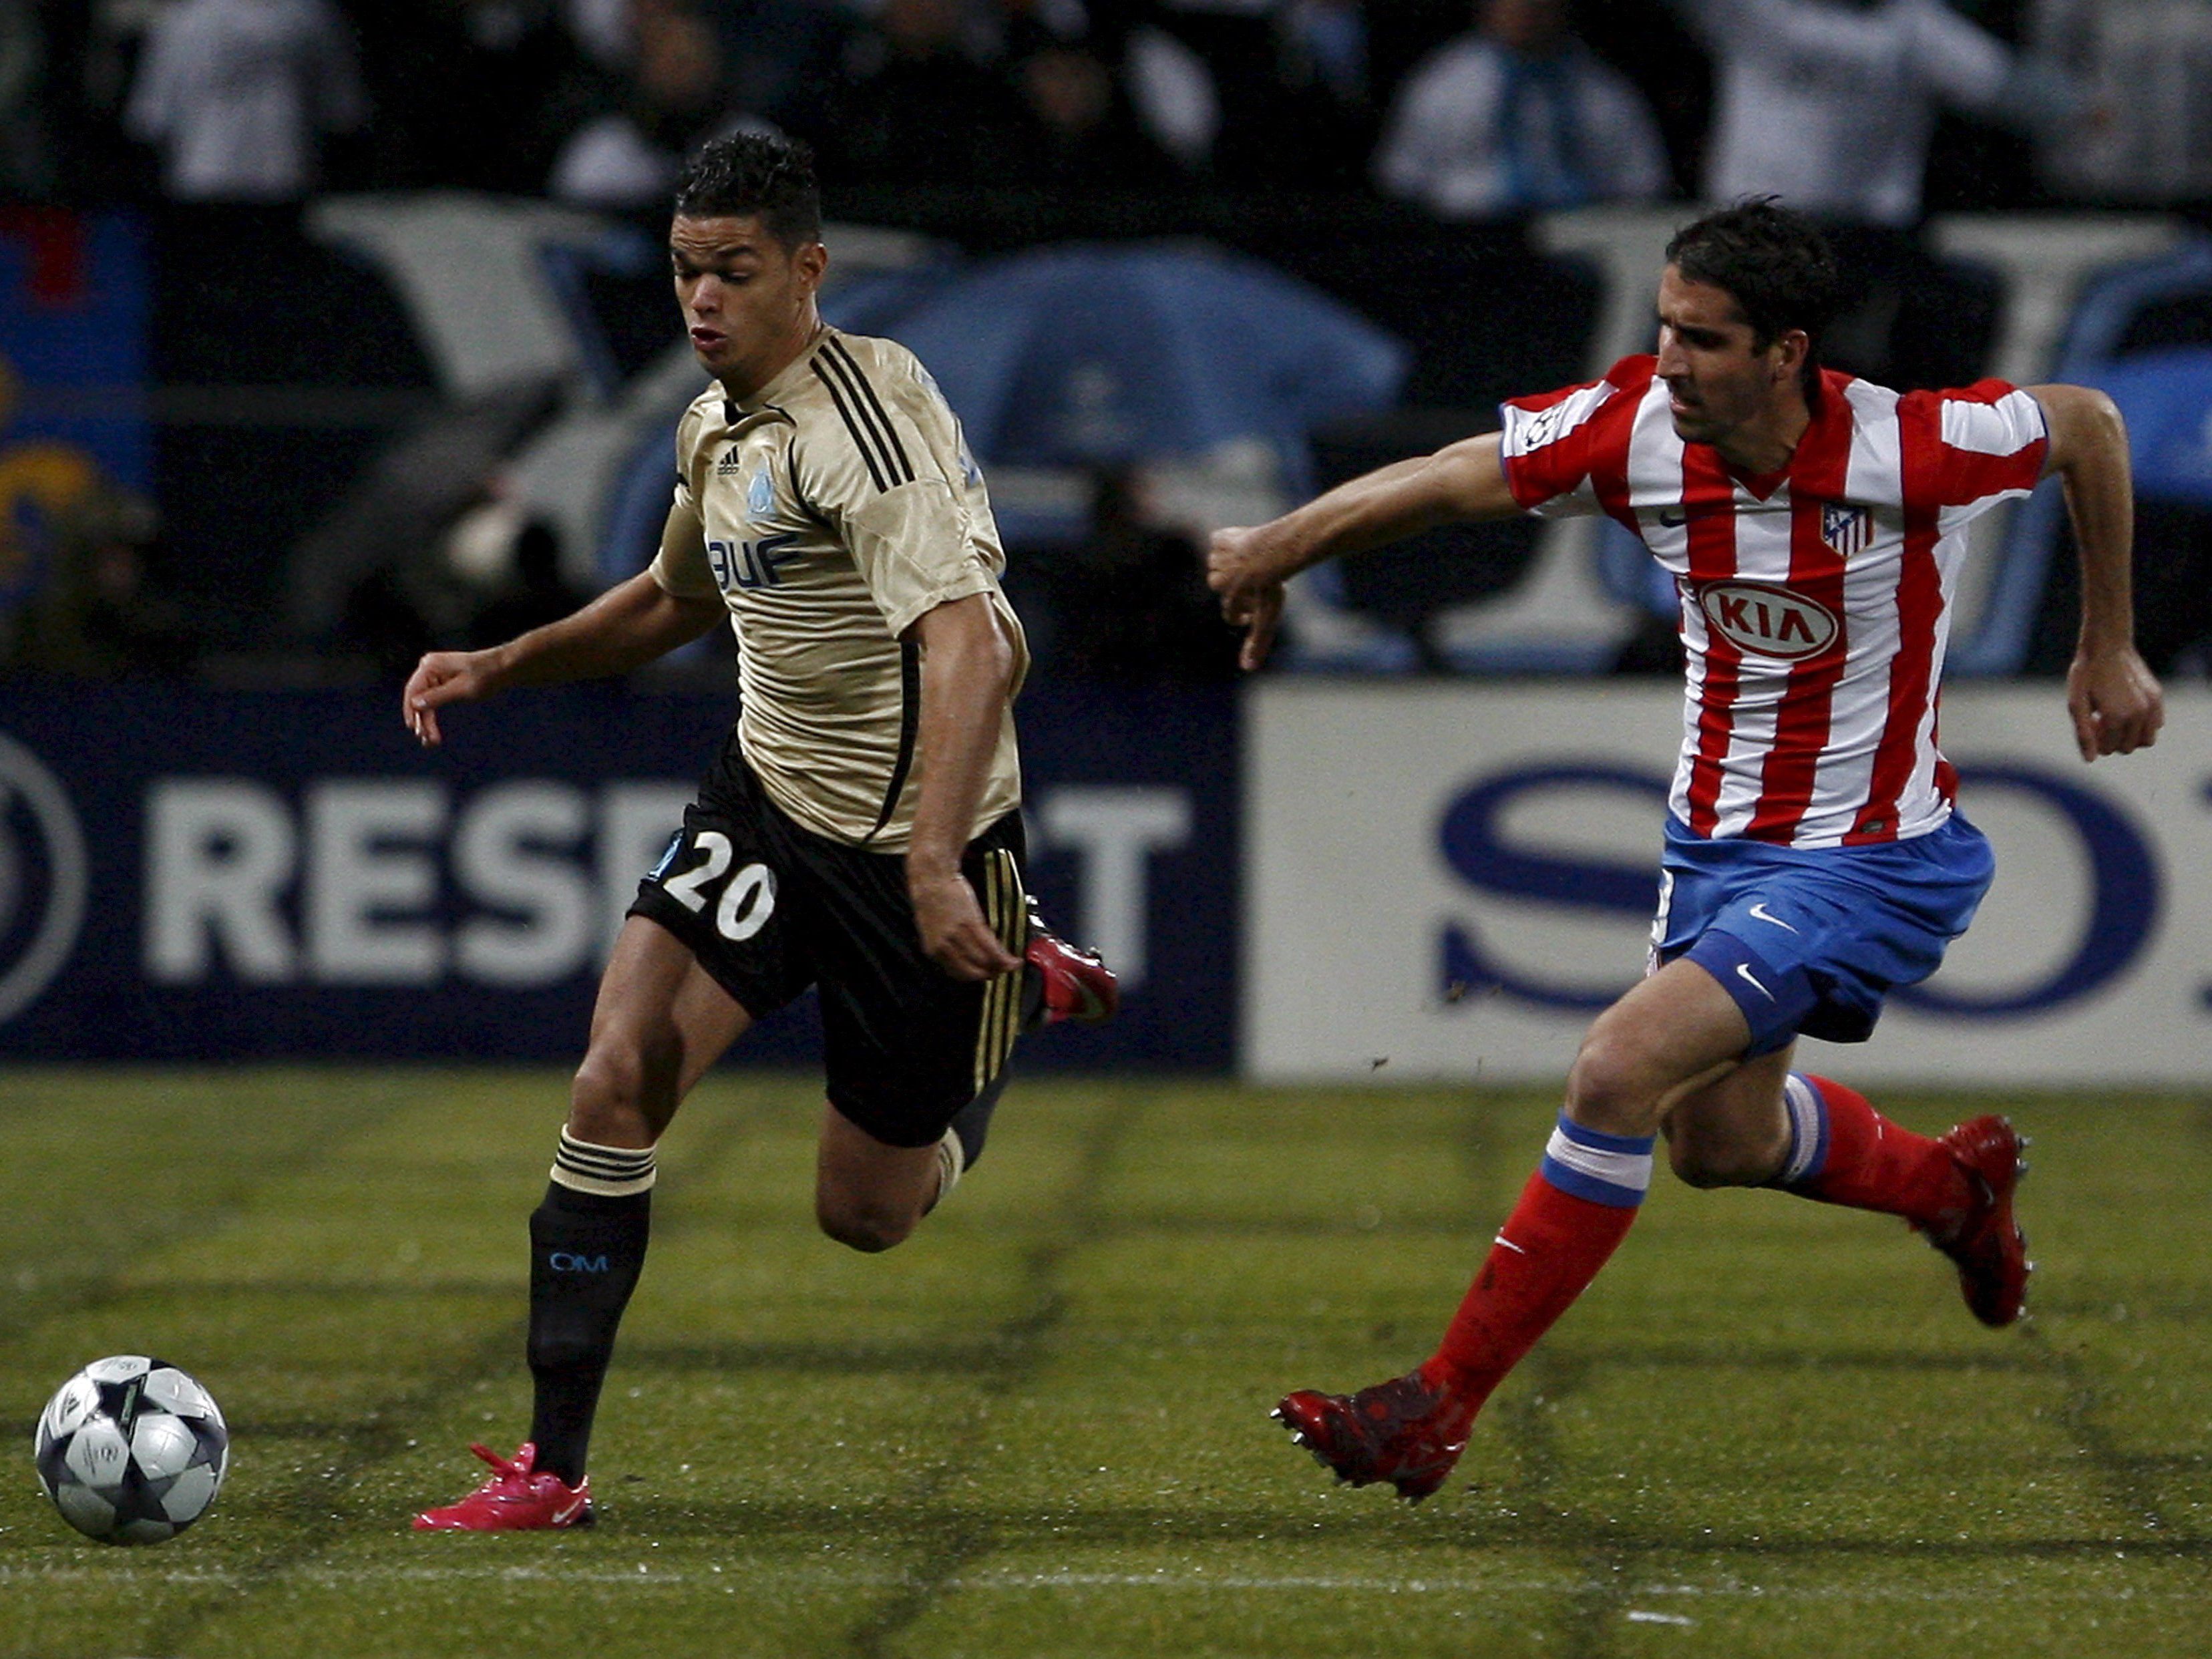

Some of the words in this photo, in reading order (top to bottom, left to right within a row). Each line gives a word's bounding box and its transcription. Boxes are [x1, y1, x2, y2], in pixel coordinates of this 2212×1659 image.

[1718, 593, 1817, 644] KIA
[143, 778, 1194, 987] RESPT
[663, 831, 779, 941] 20
[1433, 756, 2212, 1023] SO
[550, 1252, 606, 1273] OM
